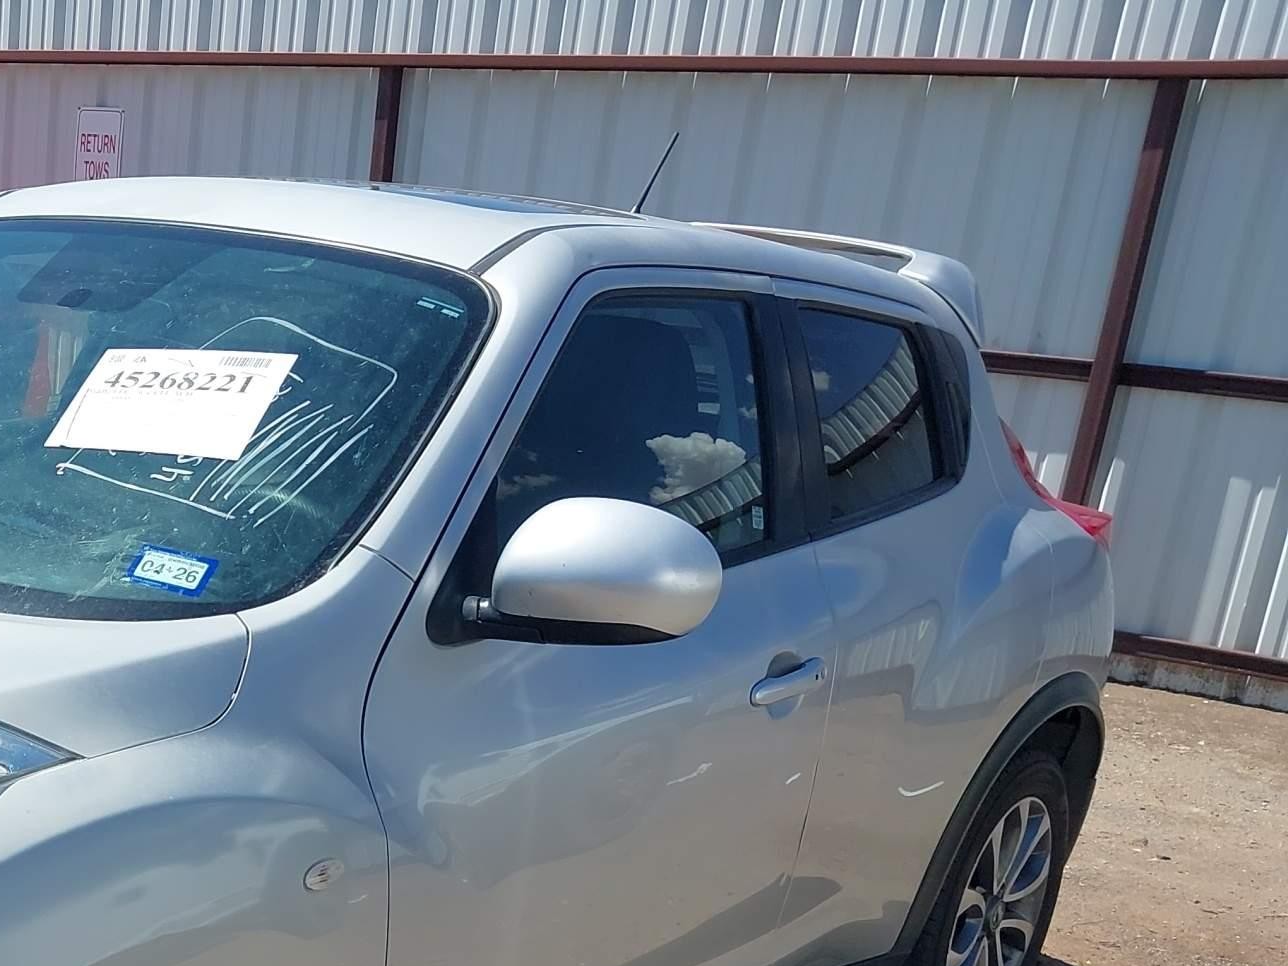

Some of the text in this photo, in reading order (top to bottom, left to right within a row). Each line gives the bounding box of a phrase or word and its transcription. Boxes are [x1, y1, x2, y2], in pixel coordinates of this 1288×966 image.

[80, 133, 116, 154] RETURN
[84, 160, 110, 180] TOWS
[104, 370, 254, 393] 45268221
